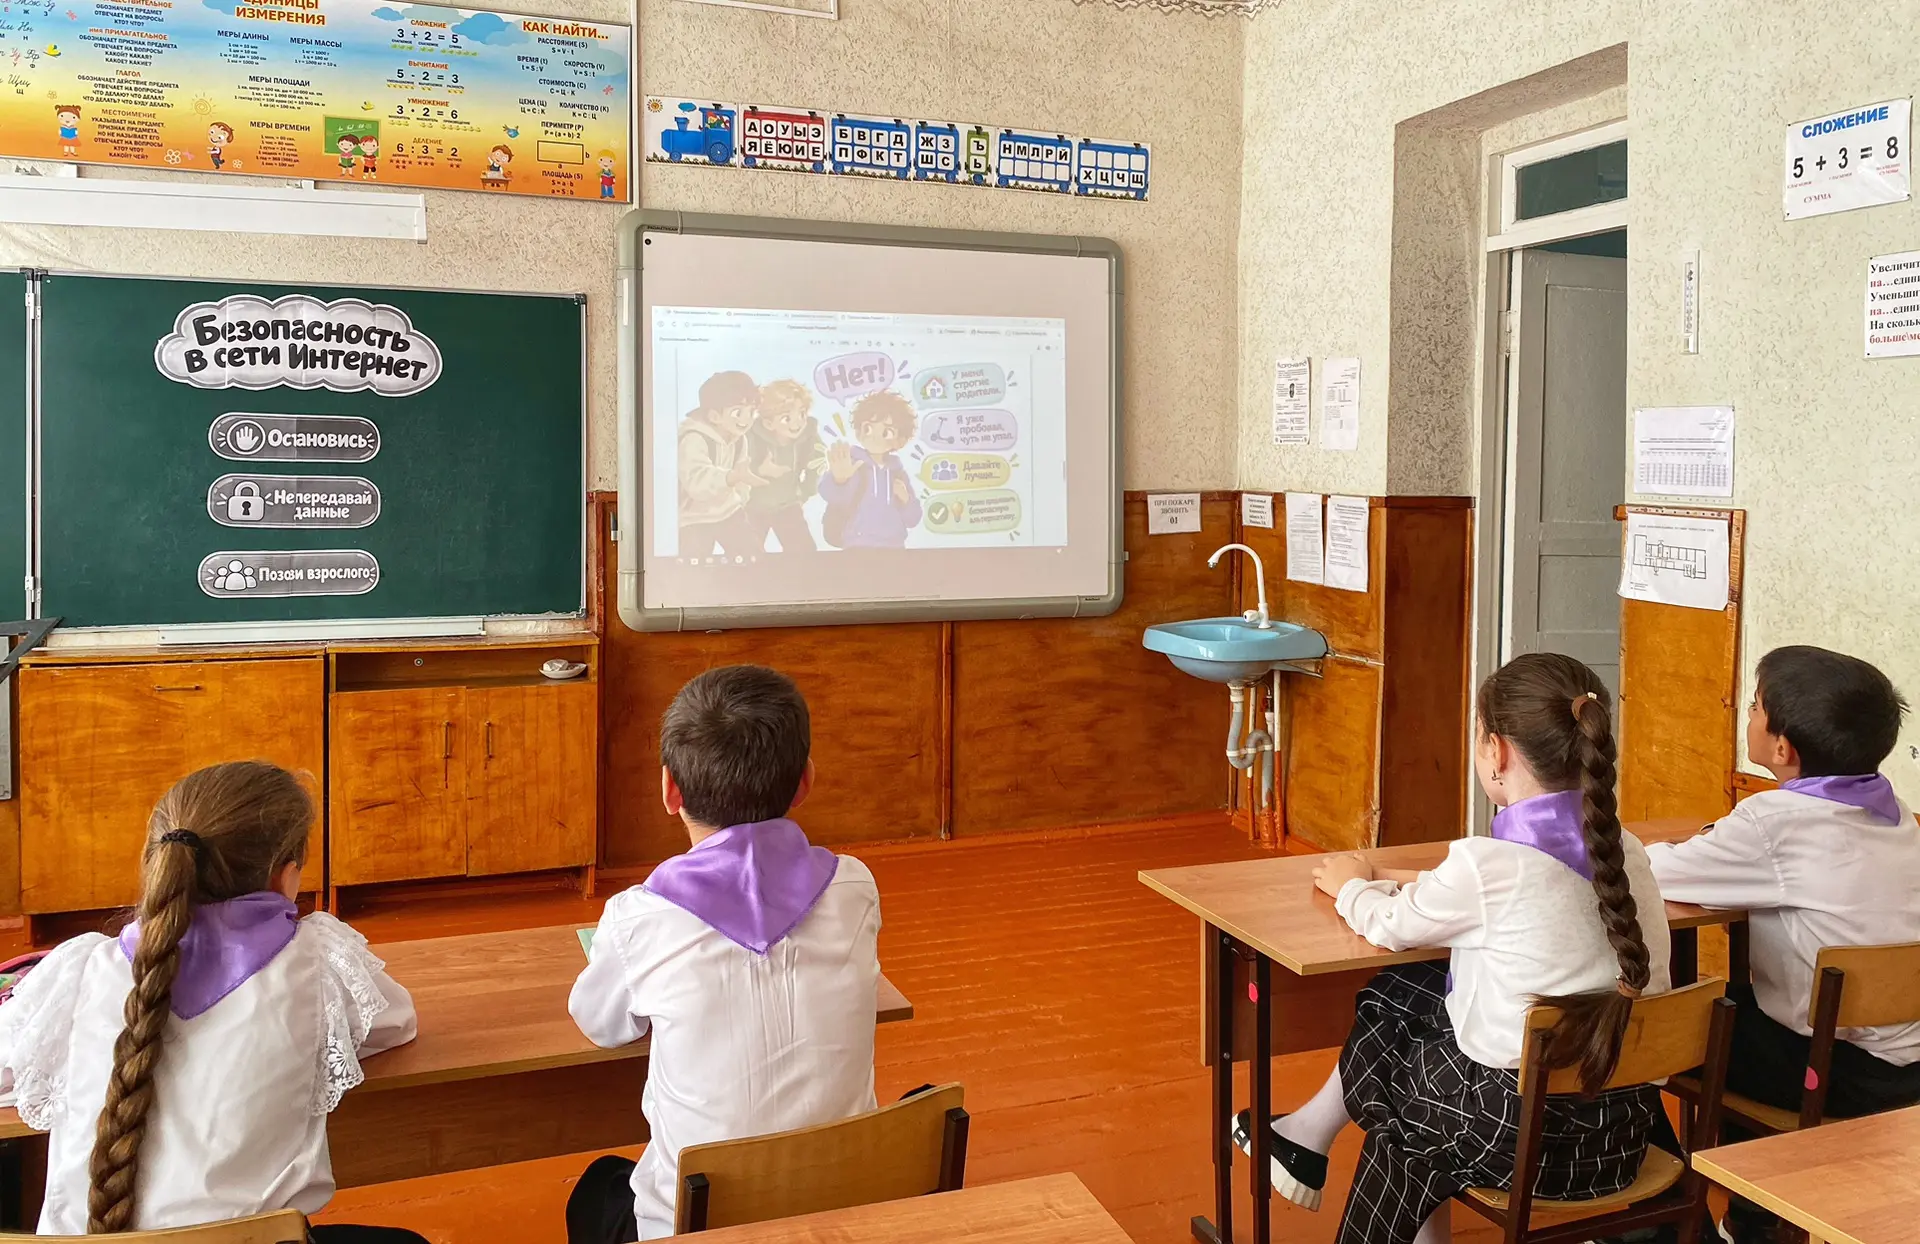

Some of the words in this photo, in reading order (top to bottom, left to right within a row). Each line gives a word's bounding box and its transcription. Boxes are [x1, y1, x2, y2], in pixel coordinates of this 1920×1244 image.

[96, 3, 134, 12] ОБОЗНАЧАЕТ
[135, 7, 162, 15] ПРЕДМЕТ
[94, 10, 124, 18] ОТВЕЧАЕТ
[134, 14, 164, 22] ВОПРОСЫ
[236, 7, 325, 25] ИЗМЕРЕНИЯ
[411, 20, 447, 29] СЛОЖЕНИЕ
[523, 21, 549, 33] КАК
[553, 23, 609, 39] НАЙТИ...
[105, 29, 168, 40] ПРИЛАГАТЕЛЬНОЕ
[217, 30, 241, 38] МЕРЫ
[242, 32, 269, 41] ДЛИНЫ
[397, 28, 404, 38] 3
[424, 31, 432, 41] 2
[451, 34, 459, 43] 5
[79, 34, 117, 43] ОБОЗНАЧАЕТ
[118, 38, 146, 46] ПРИЗНАК
[147, 41, 178, 49] ПРЕДМЕТА
[289, 37, 312, 45] МЕРЫ
[314, 39, 342, 48] МАССЫ
[537, 37, 578, 47] РАССТОЯНИЕ
[578, 41, 588, 49] (S)
[408, 60, 449, 70] ВЫЧИТАНИЕ
[517, 55, 539, 63] ВРЕМЯ
[563, 60, 596, 69] СКОРОСТЬ
[116, 69, 141, 77] ГЛАГОЛ
[397, 69, 404, 78] 5
[422, 71, 429, 81] 2
[452, 74, 459, 84] 3
[78, 74, 116, 83] ОБОЗНАЧАЕТ
[148, 81, 179, 89] ПРЕДМЕТА
[248, 75, 272, 83] МЕРЫ
[273, 77, 310, 87] ПЛОЩАДИ
[538, 78, 576, 87] СТОИМОСТЬ
[407, 98, 450, 107] УМНОЖЕНИЕ
[518, 98, 536, 106] ЦЕНА
[559, 102, 599, 111] КОЛИЧЕСТВО
[101, 108, 156, 119] МЕСТОИМЕНИЕ
[396, 105, 404, 115] 3
[422, 107, 430, 117] 2
[451, 109, 458, 119] 6
[274, 123, 310, 132] ВРЕМЕНИ
[541, 121, 574, 130] ПЕРИМЕТР
[1802, 106, 1889, 138] СЛОЖЕНИЕ
[747, 122, 758, 133] А
[764, 124, 774, 134] О
[781, 125, 790, 135] У
[794, 126, 806, 137] Ы
[811, 127, 821, 138] Э
[413, 137, 442, 145] ДЕЛЕНИЕ
[840, 129, 849, 139] Б
[857, 131, 866, 141] В
[876, 132, 884, 142] Г
[893, 134, 904, 146] Д
[920, 135, 934, 147] Ж
[942, 138, 950, 149] З
[397, 143, 404, 152] 6
[422, 145, 429, 154] 3
[451, 147, 458, 157] 2
[748, 141, 757, 152] Я
[764, 141, 773, 154] Ё
[778, 143, 791, 154] Ю
[796, 145, 805, 156] И
[812, 146, 820, 157] Е
[973, 140, 984, 151] Ъ
[839, 148, 849, 158] П
[857, 149, 867, 160] Ф
[876, 151, 884, 161] К
[894, 153, 903, 163] Т
[1003, 144, 1012, 154] Н
[1017, 145, 1026, 156] М
[1031, 147, 1040, 157] Л
[1045, 149, 1053, 159] Р
[1059, 148, 1068, 161] Й
[1793, 156, 1804, 179] 5
[1815, 155, 1826, 171] +
[1838, 147, 1848, 169] 3
[1860, 146, 1872, 160] =
[1886, 136, 1898, 159] 8
[921, 153, 933, 165] Ш
[942, 156, 950, 167] С
[973, 158, 982, 169] Ь
[541, 170, 573, 179] ПЛОЩАДЬ
[1083, 170, 1092, 180] Х
[1100, 172, 1109, 183] Ц
[1116, 173, 1125, 183] Ч
[1132, 174, 1143, 186] Щ
[1803, 193, 1832, 203] СУММА
[1871, 289, 1920, 302] Уменьши
[1870, 320, 1884, 330] На
[192, 314, 410, 352] Безопасность
[184, 349, 208, 373] в
[214, 346, 280, 368] сети
[288, 343, 427, 380] Интернет
[824, 357, 887, 392] Нет!
[952, 370, 959, 380] У
[961, 369, 986, 378] меня
[957, 415, 964, 424] Я
[266, 429, 368, 448] Остановись
[1154, 499, 1167, 507] ПРИ
[1168, 498, 1194, 506] ПОЖАРЕ
[293, 507, 350, 520] данные
[1169, 516, 1178, 525] 01
[259, 567, 304, 582] Позови
[307, 567, 370, 583] взрослого
